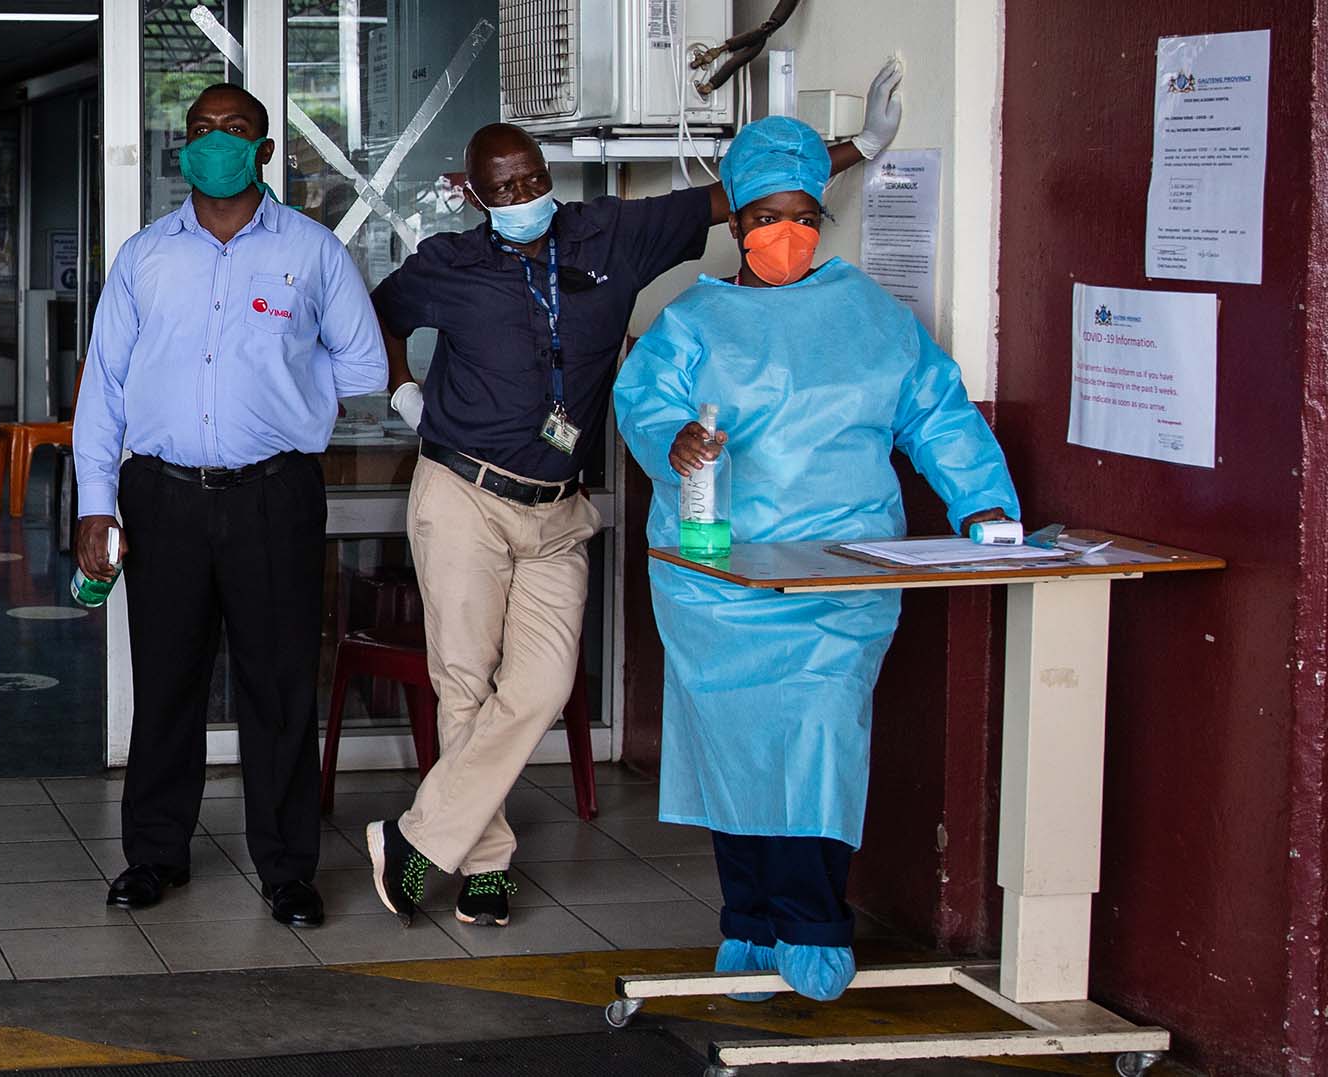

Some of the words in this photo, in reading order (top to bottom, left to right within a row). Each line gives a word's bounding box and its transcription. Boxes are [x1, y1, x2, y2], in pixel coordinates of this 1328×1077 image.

[1224, 75, 1251, 83] PROVINCE
[268, 308, 293, 320] VIMBA
[1083, 331, 1103, 342] COVID
[1118, 367, 1135, 376] inform
[1160, 371, 1173, 381] have
[1142, 385, 1152, 393] past
[1118, 399, 1130, 407] soon
[1138, 402, 1148, 410] you
